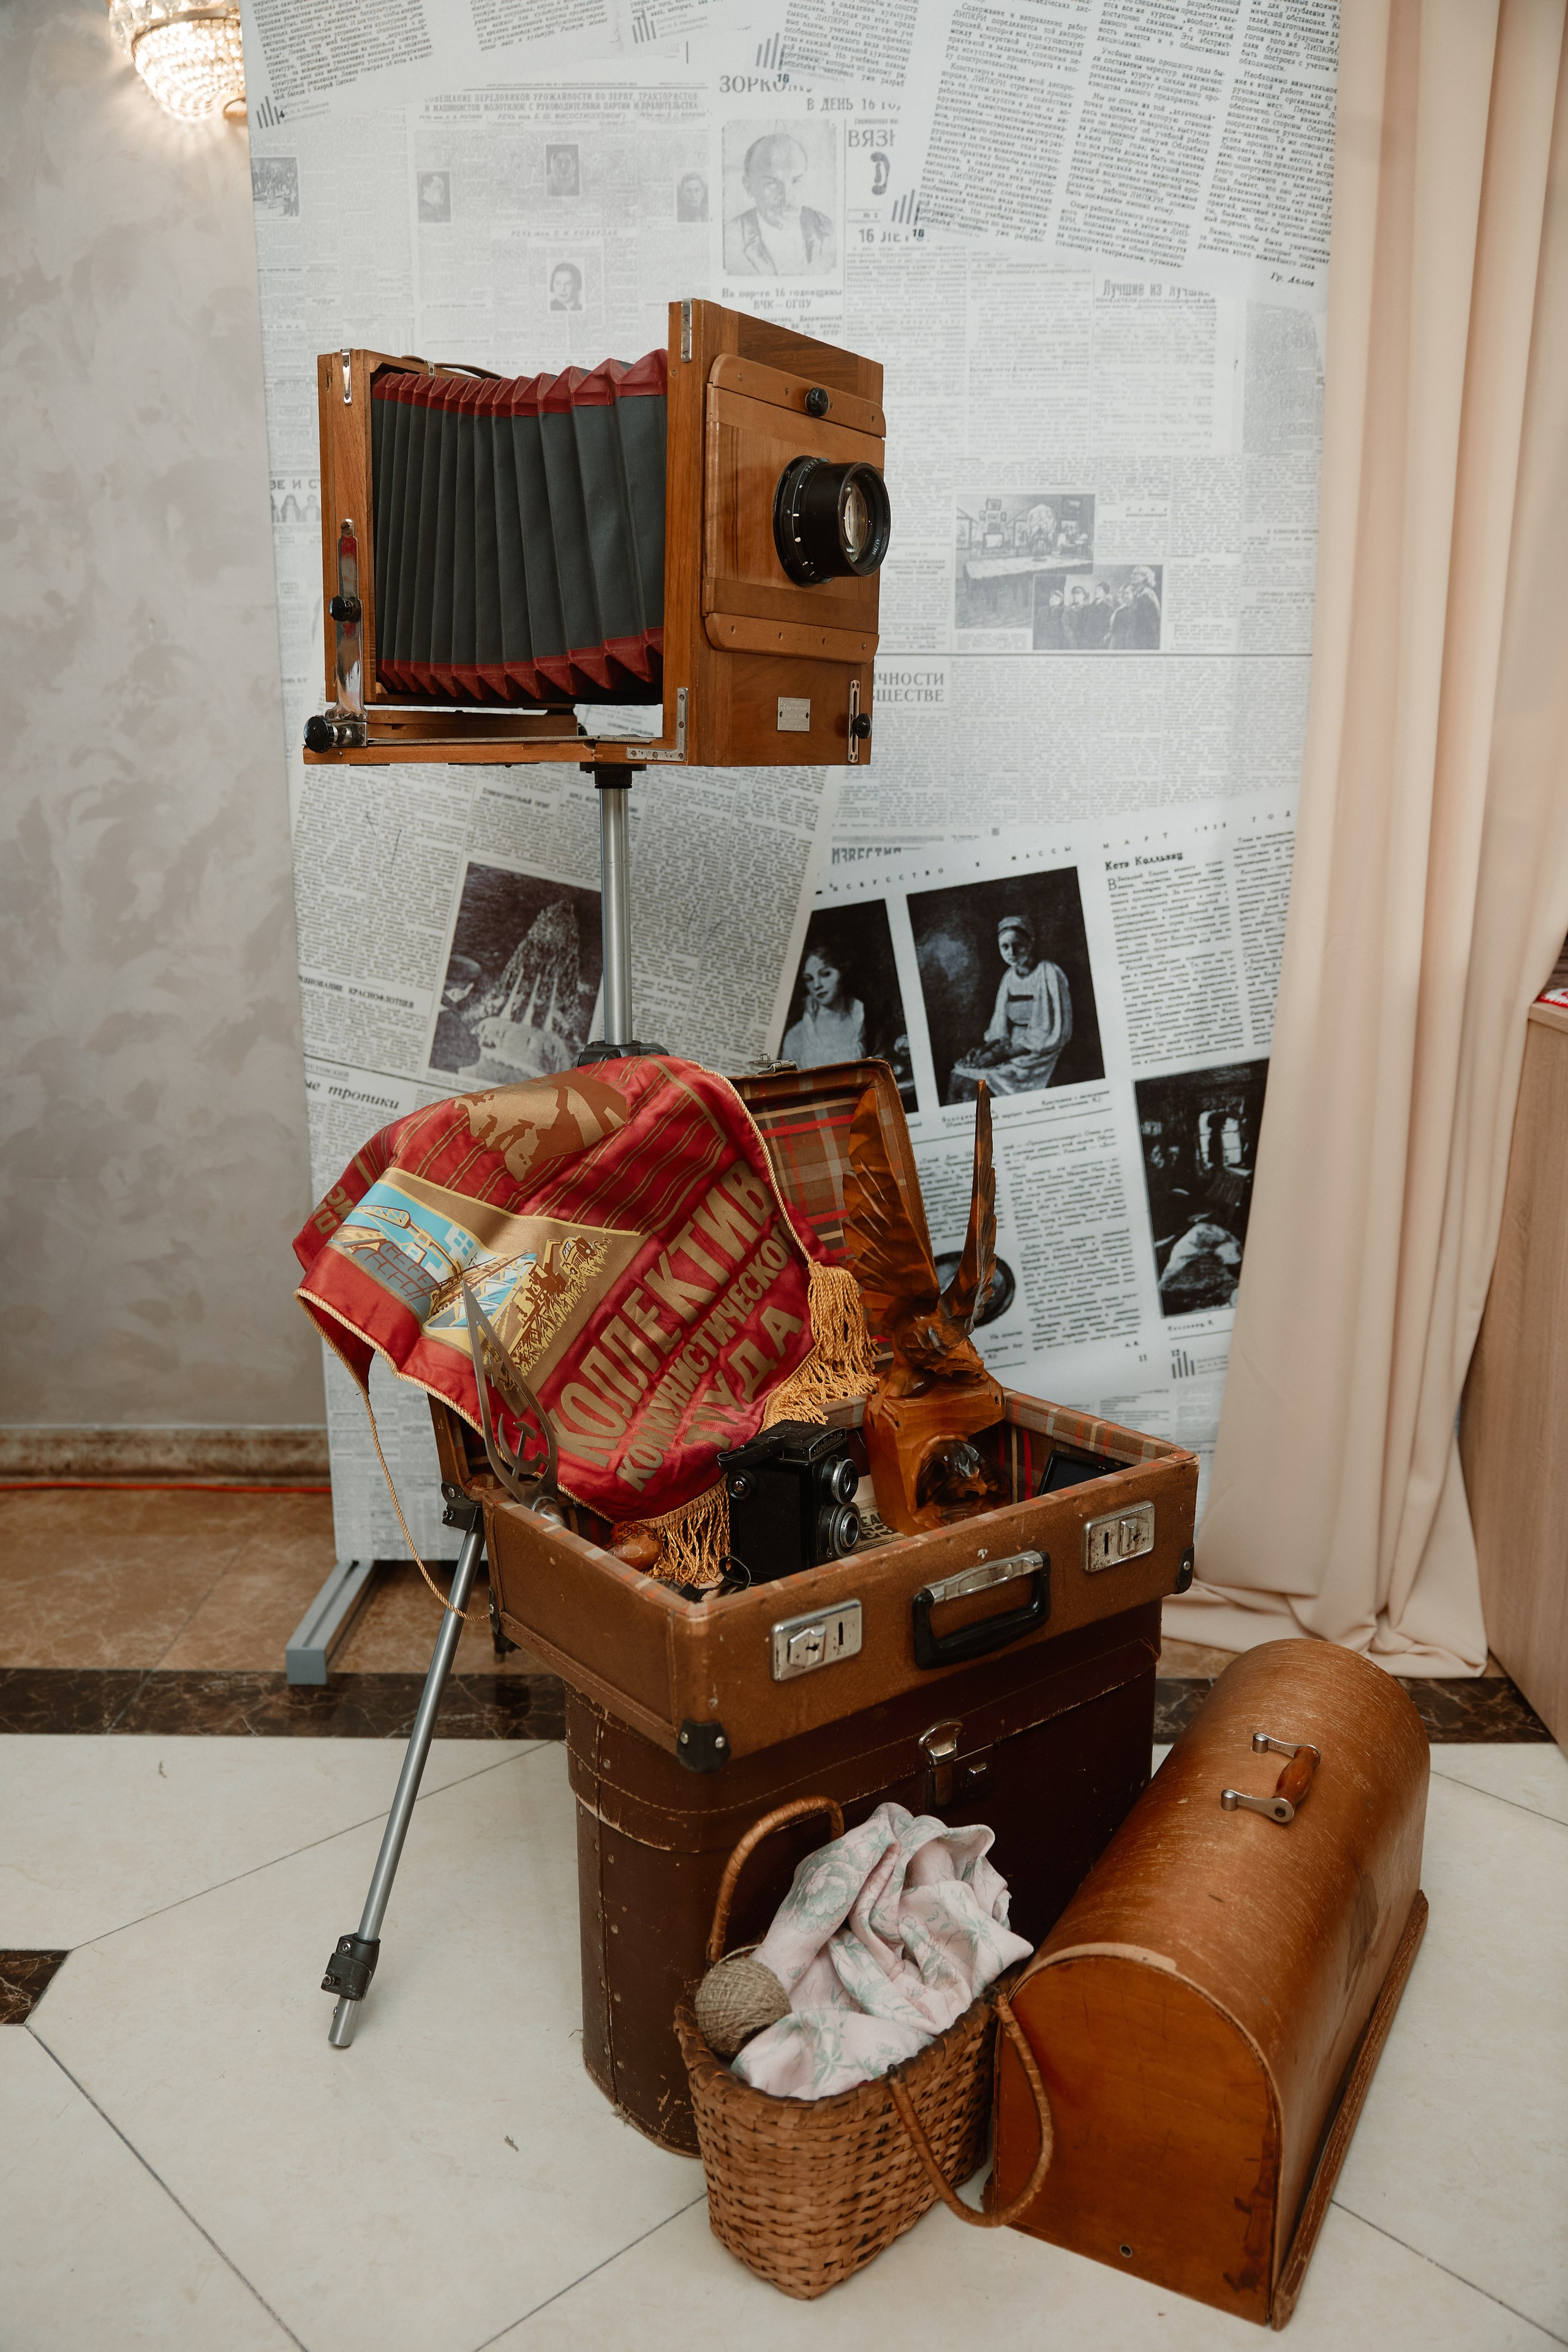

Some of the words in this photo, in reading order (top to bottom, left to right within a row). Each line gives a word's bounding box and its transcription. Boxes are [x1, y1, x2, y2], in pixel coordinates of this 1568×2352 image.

[807, 97, 815, 111] В
[821, 97, 853, 111] ДЕНЬ
[862, 98, 875, 110] 16
[859, 228, 874, 243] 16
[1102, 279, 1145, 301] Лучшие
[1150, 283, 1163, 296] из
[873, 672, 944, 685] ЧНОСТИ
[873, 689, 944, 703] ЩЕСТВЕ
[328, 1086, 399, 1109] тропики
[554, 1159, 776, 1468] КОЛЛЕКТИВ
[812, 1431, 842, 1456] Любитель
